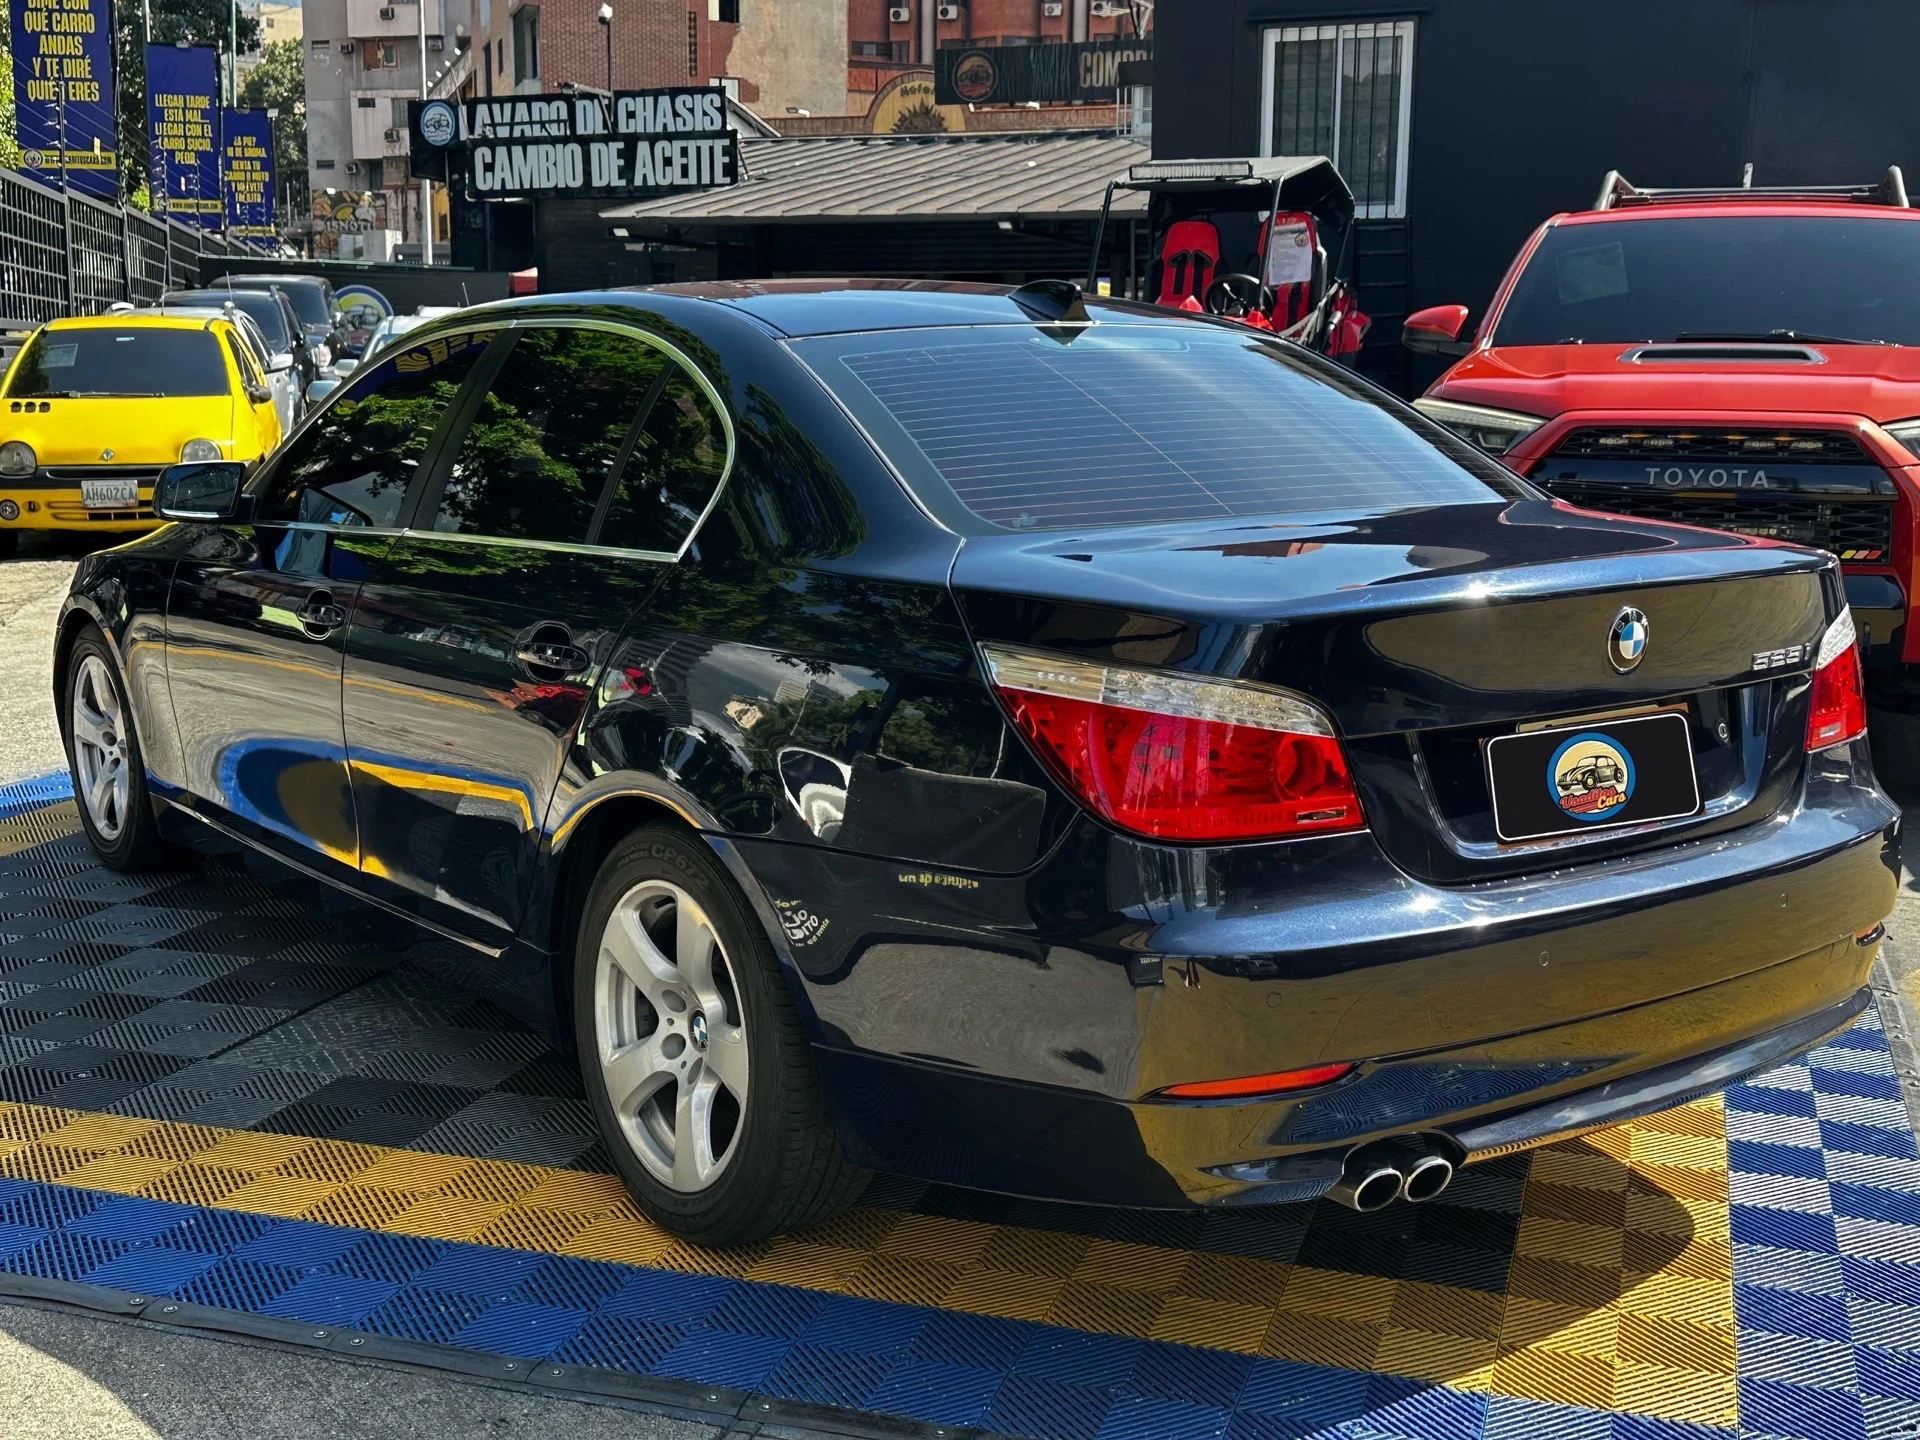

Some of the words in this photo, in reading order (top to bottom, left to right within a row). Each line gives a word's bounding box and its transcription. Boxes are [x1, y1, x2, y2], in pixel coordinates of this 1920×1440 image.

[24, 8, 49, 33] QUÉ
[51, 12, 95, 33] CARRO
[39, 35, 83, 55] ANDAS
[32, 57, 41, 77] Y
[45, 57, 60, 78] TE
[62, 54, 92, 79] DIRÉ
[68, 81, 100, 101] ERES
[155, 93, 184, 107] LLEGAR
[186, 95, 210, 109] TARDE
[617, 93, 723, 133] CHASIS
[155, 122, 184, 135] LLEGAR
[186, 123, 202, 137] CON
[474, 143, 583, 191] CAMBIO
[589, 141, 626, 187] DE
[634, 138, 731, 187] ACEITE
[1645, 467, 1769, 488] TOYOTA
[86, 487, 135, 501] AH602CA
[1597, 792, 1627, 809] Cars
